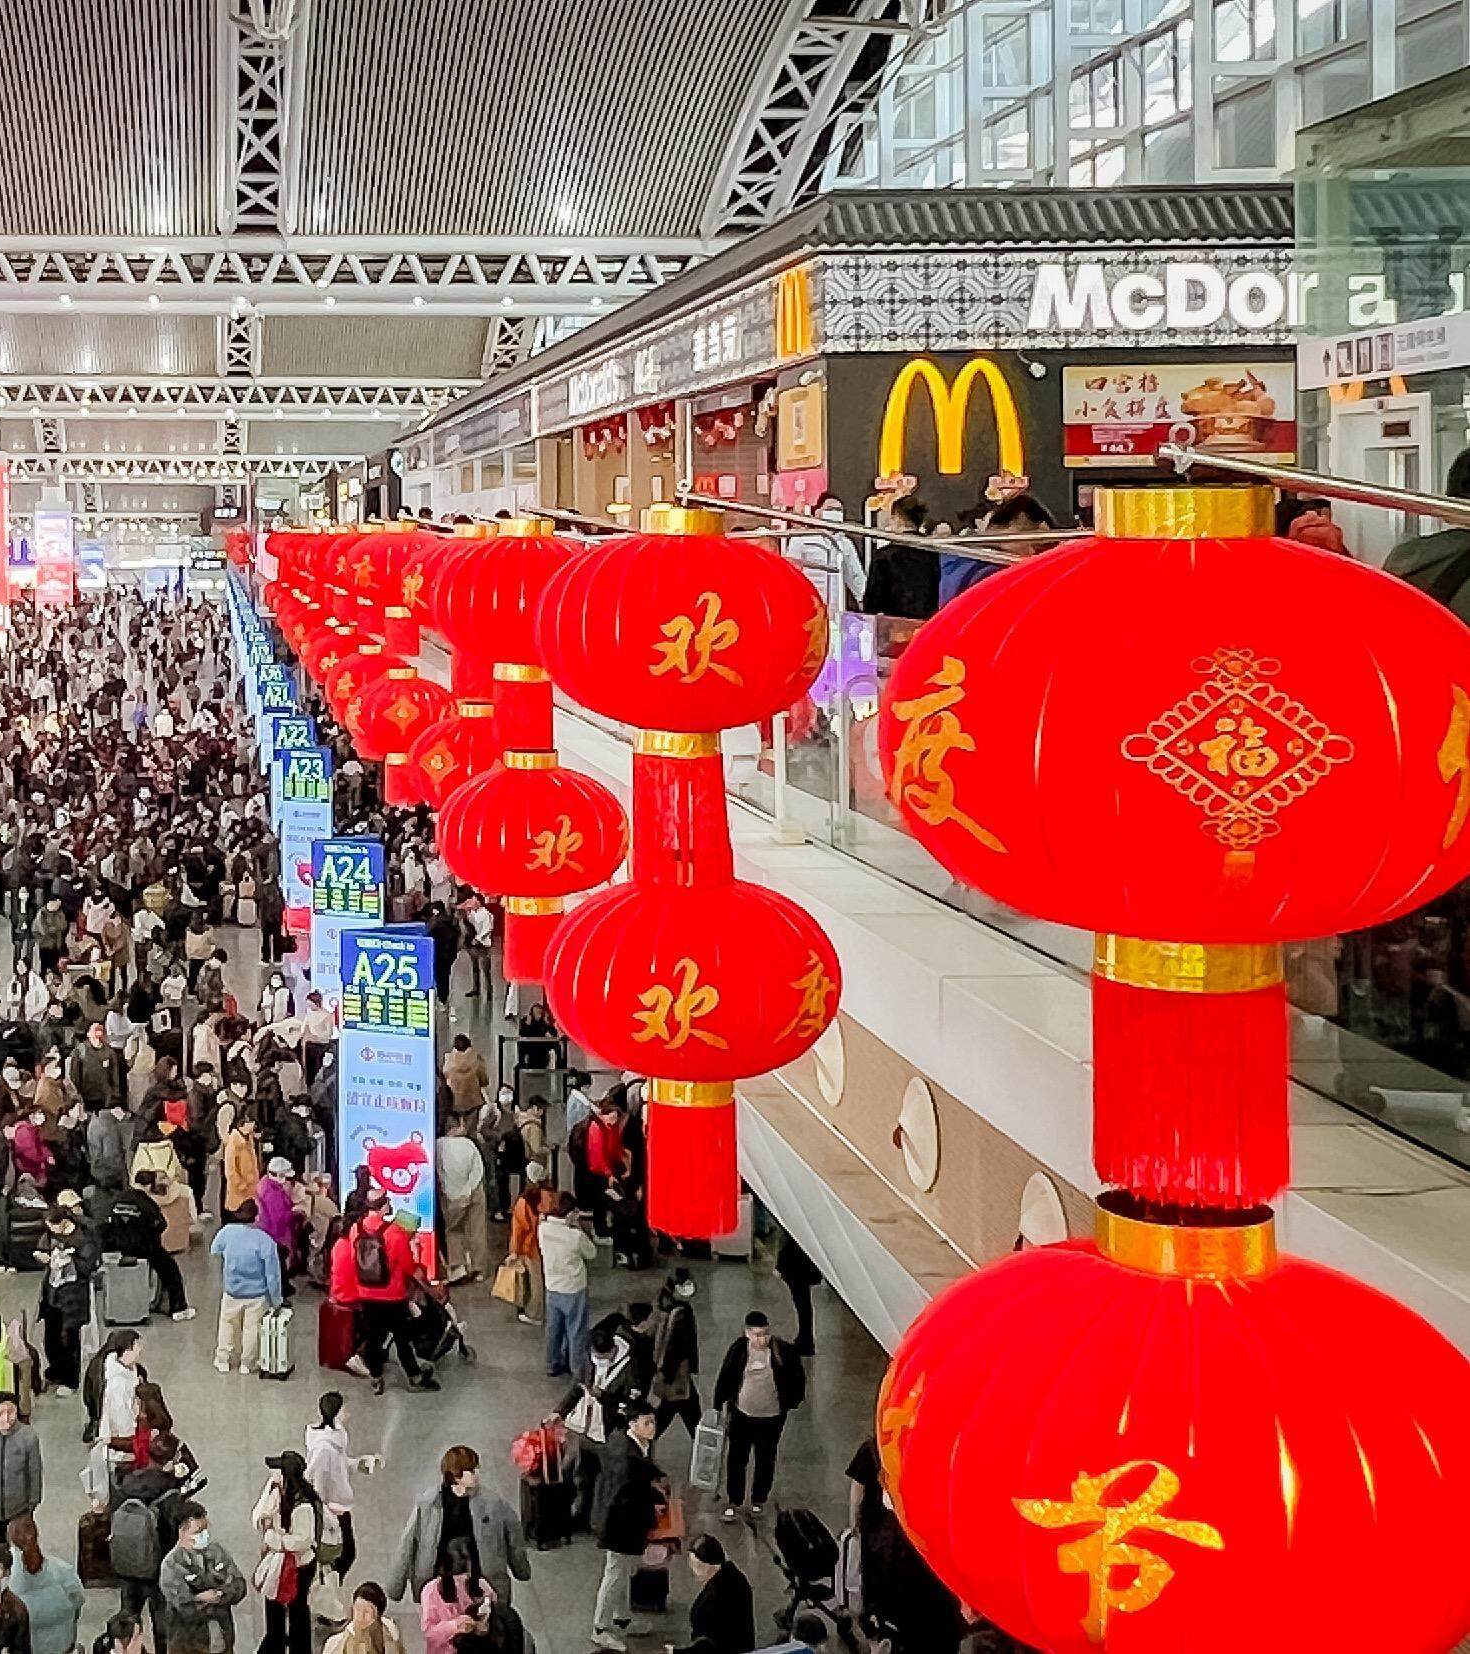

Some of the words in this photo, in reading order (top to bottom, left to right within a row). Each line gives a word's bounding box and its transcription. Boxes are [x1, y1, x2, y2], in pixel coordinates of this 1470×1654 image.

[650, 591, 744, 687] 欢
[277, 725, 311, 749] A22
[891, 656, 1009, 853] 度
[1199, 717, 1281, 777] 福
[288, 759, 324, 780] A23
[321, 855, 374, 883] A24
[525, 814, 586, 876] 欢
[353, 950, 418, 990] A25
[632, 956, 731, 1051] 欢
[1010, 1460, 1226, 1644] 节
